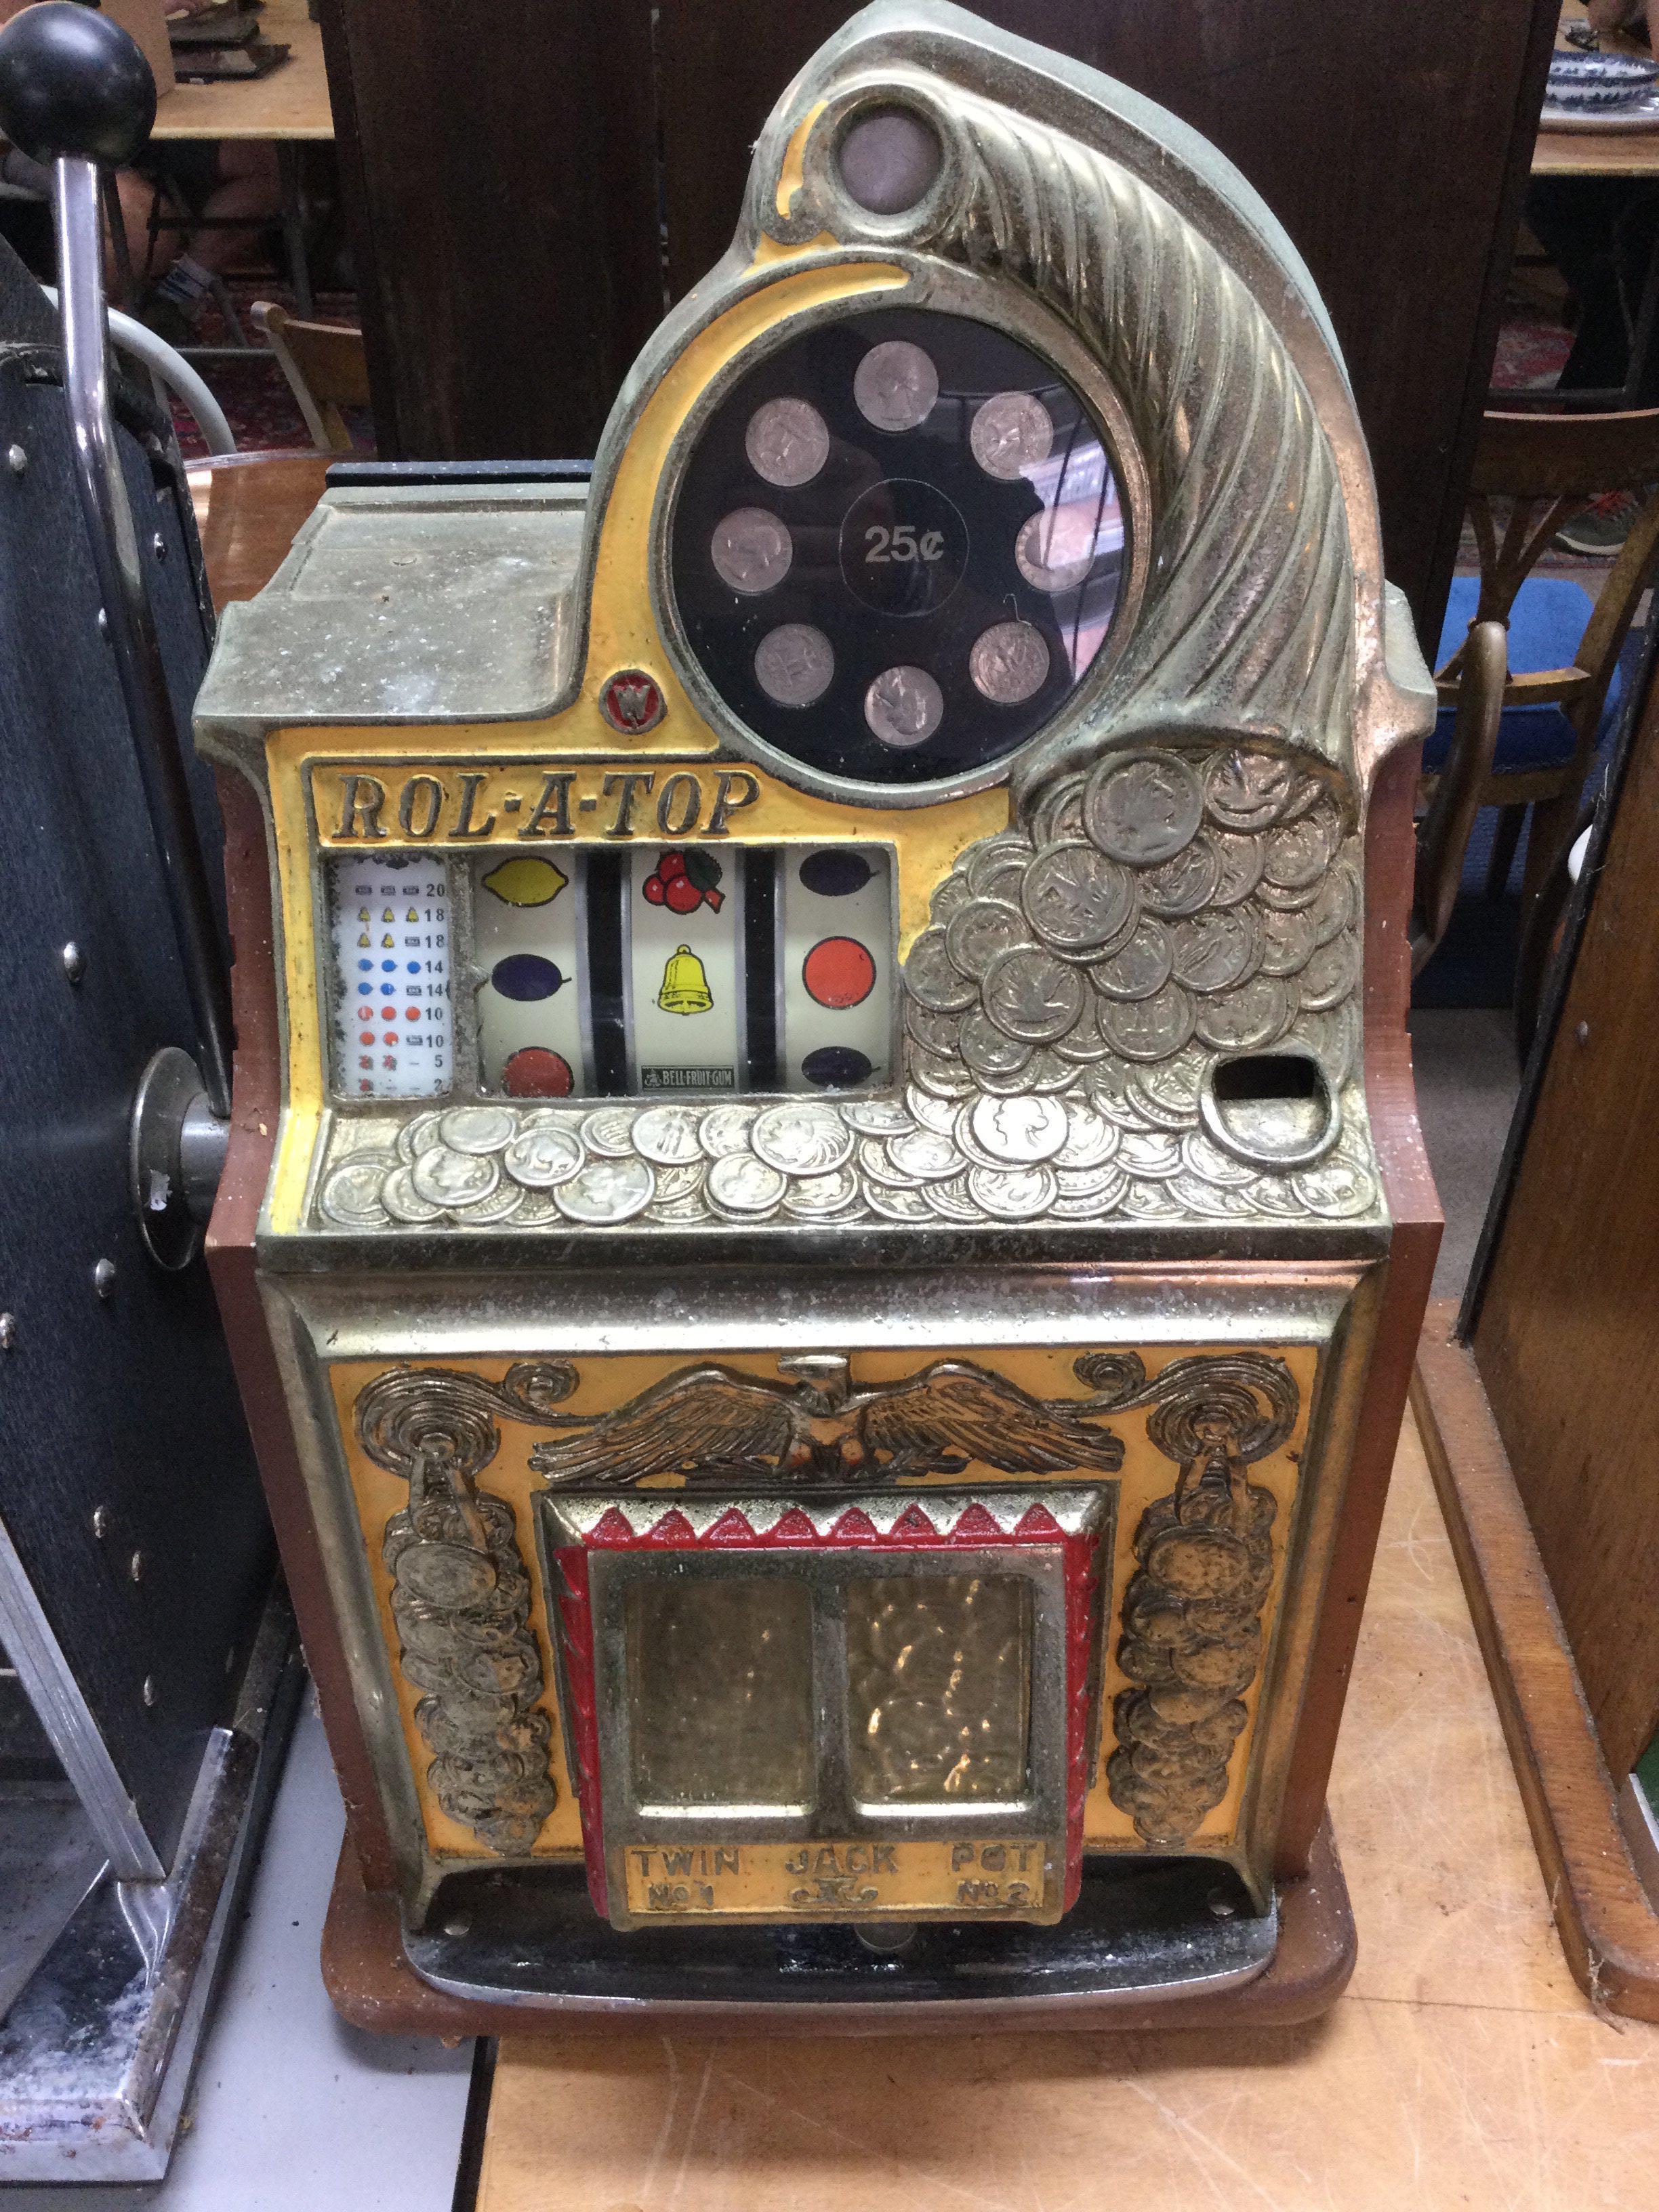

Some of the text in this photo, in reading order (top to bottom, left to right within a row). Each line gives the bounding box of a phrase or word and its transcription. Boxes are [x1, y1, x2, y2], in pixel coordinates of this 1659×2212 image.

[865, 525, 944, 563] 25¢
[332, 770, 759, 838] ROL-A-TOP
[426, 883, 445, 897] 20
[424, 907, 445, 922] 18
[425, 934, 445, 948] 18
[425, 960, 443, 973] 14
[426, 983, 443, 996] 14
[425, 1007, 443, 1021] 10
[426, 1034, 444, 1048] 10
[434, 1054, 443, 1067] 5
[630, 1841, 1038, 1877] TWIN JACK POT
[1007, 1880, 1030, 1906] 2
